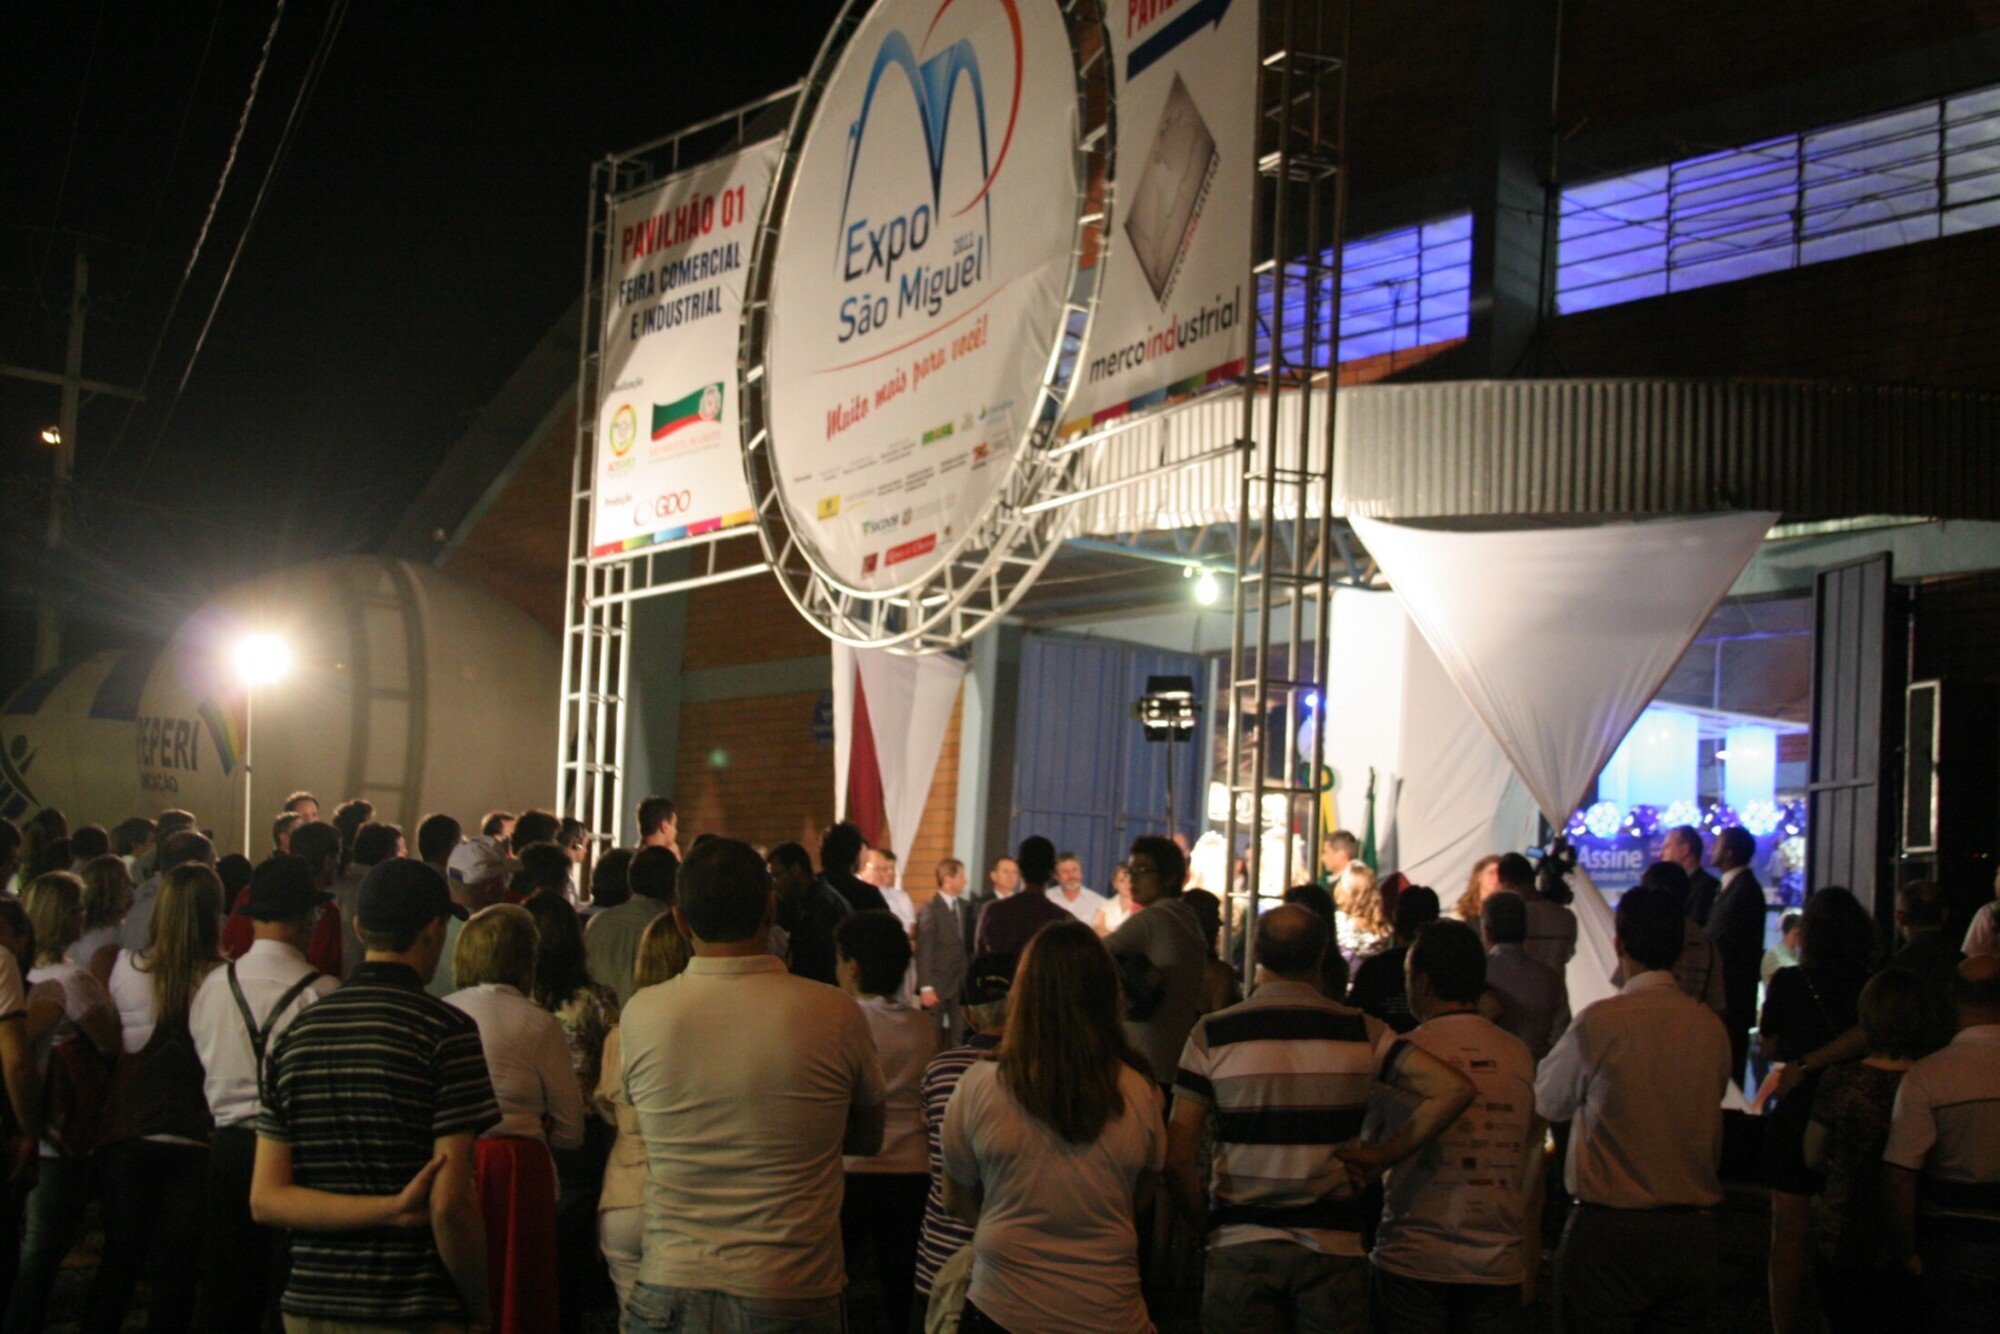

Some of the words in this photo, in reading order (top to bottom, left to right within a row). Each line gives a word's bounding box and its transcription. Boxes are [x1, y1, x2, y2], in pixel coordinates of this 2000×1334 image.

[621, 192, 715, 265] PAVILHÃO
[722, 184, 746, 228] 01
[844, 204, 931, 283] Expo
[619, 270, 655, 307] FEIRA
[660, 241, 741, 293] COMERCIAL
[630, 313, 639, 340] E
[642, 287, 722, 338] INDUSTRIAL
[838, 293, 889, 343] São
[898, 236, 984, 318] Miguel
[1089, 285, 1241, 384] mercoindustrial
[826, 395, 869, 441] Muito
[875, 367, 907, 409] mais
[913, 348, 946, 391] para
[1577, 844, 1643, 869] Assine
